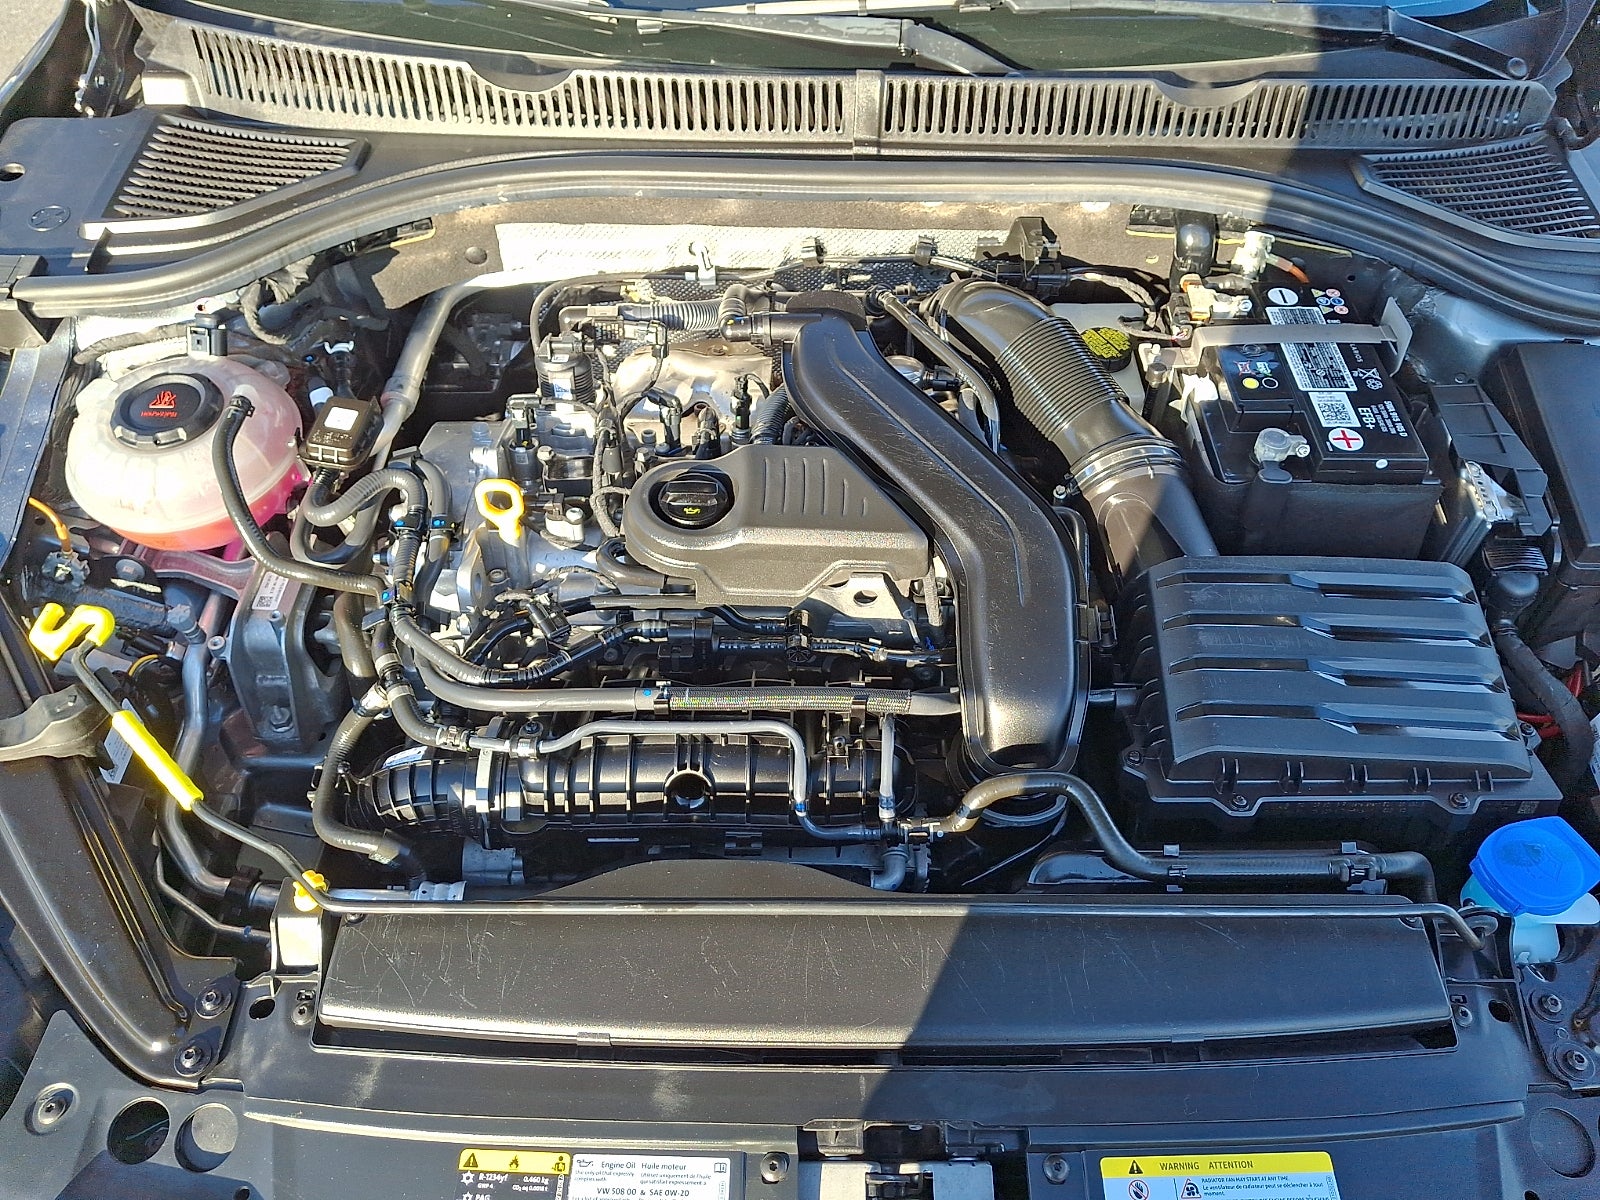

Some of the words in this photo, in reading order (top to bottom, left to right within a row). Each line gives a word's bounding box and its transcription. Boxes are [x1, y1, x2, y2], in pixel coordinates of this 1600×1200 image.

[1358, 408, 1376, 430] EFB+
[601, 1161, 624, 1170] Engine
[1160, 1162, 1200, 1170] WARNING
[1208, 1160, 1254, 1169] ATTENTION
[478, 1173, 508, 1183] R-1234yf
